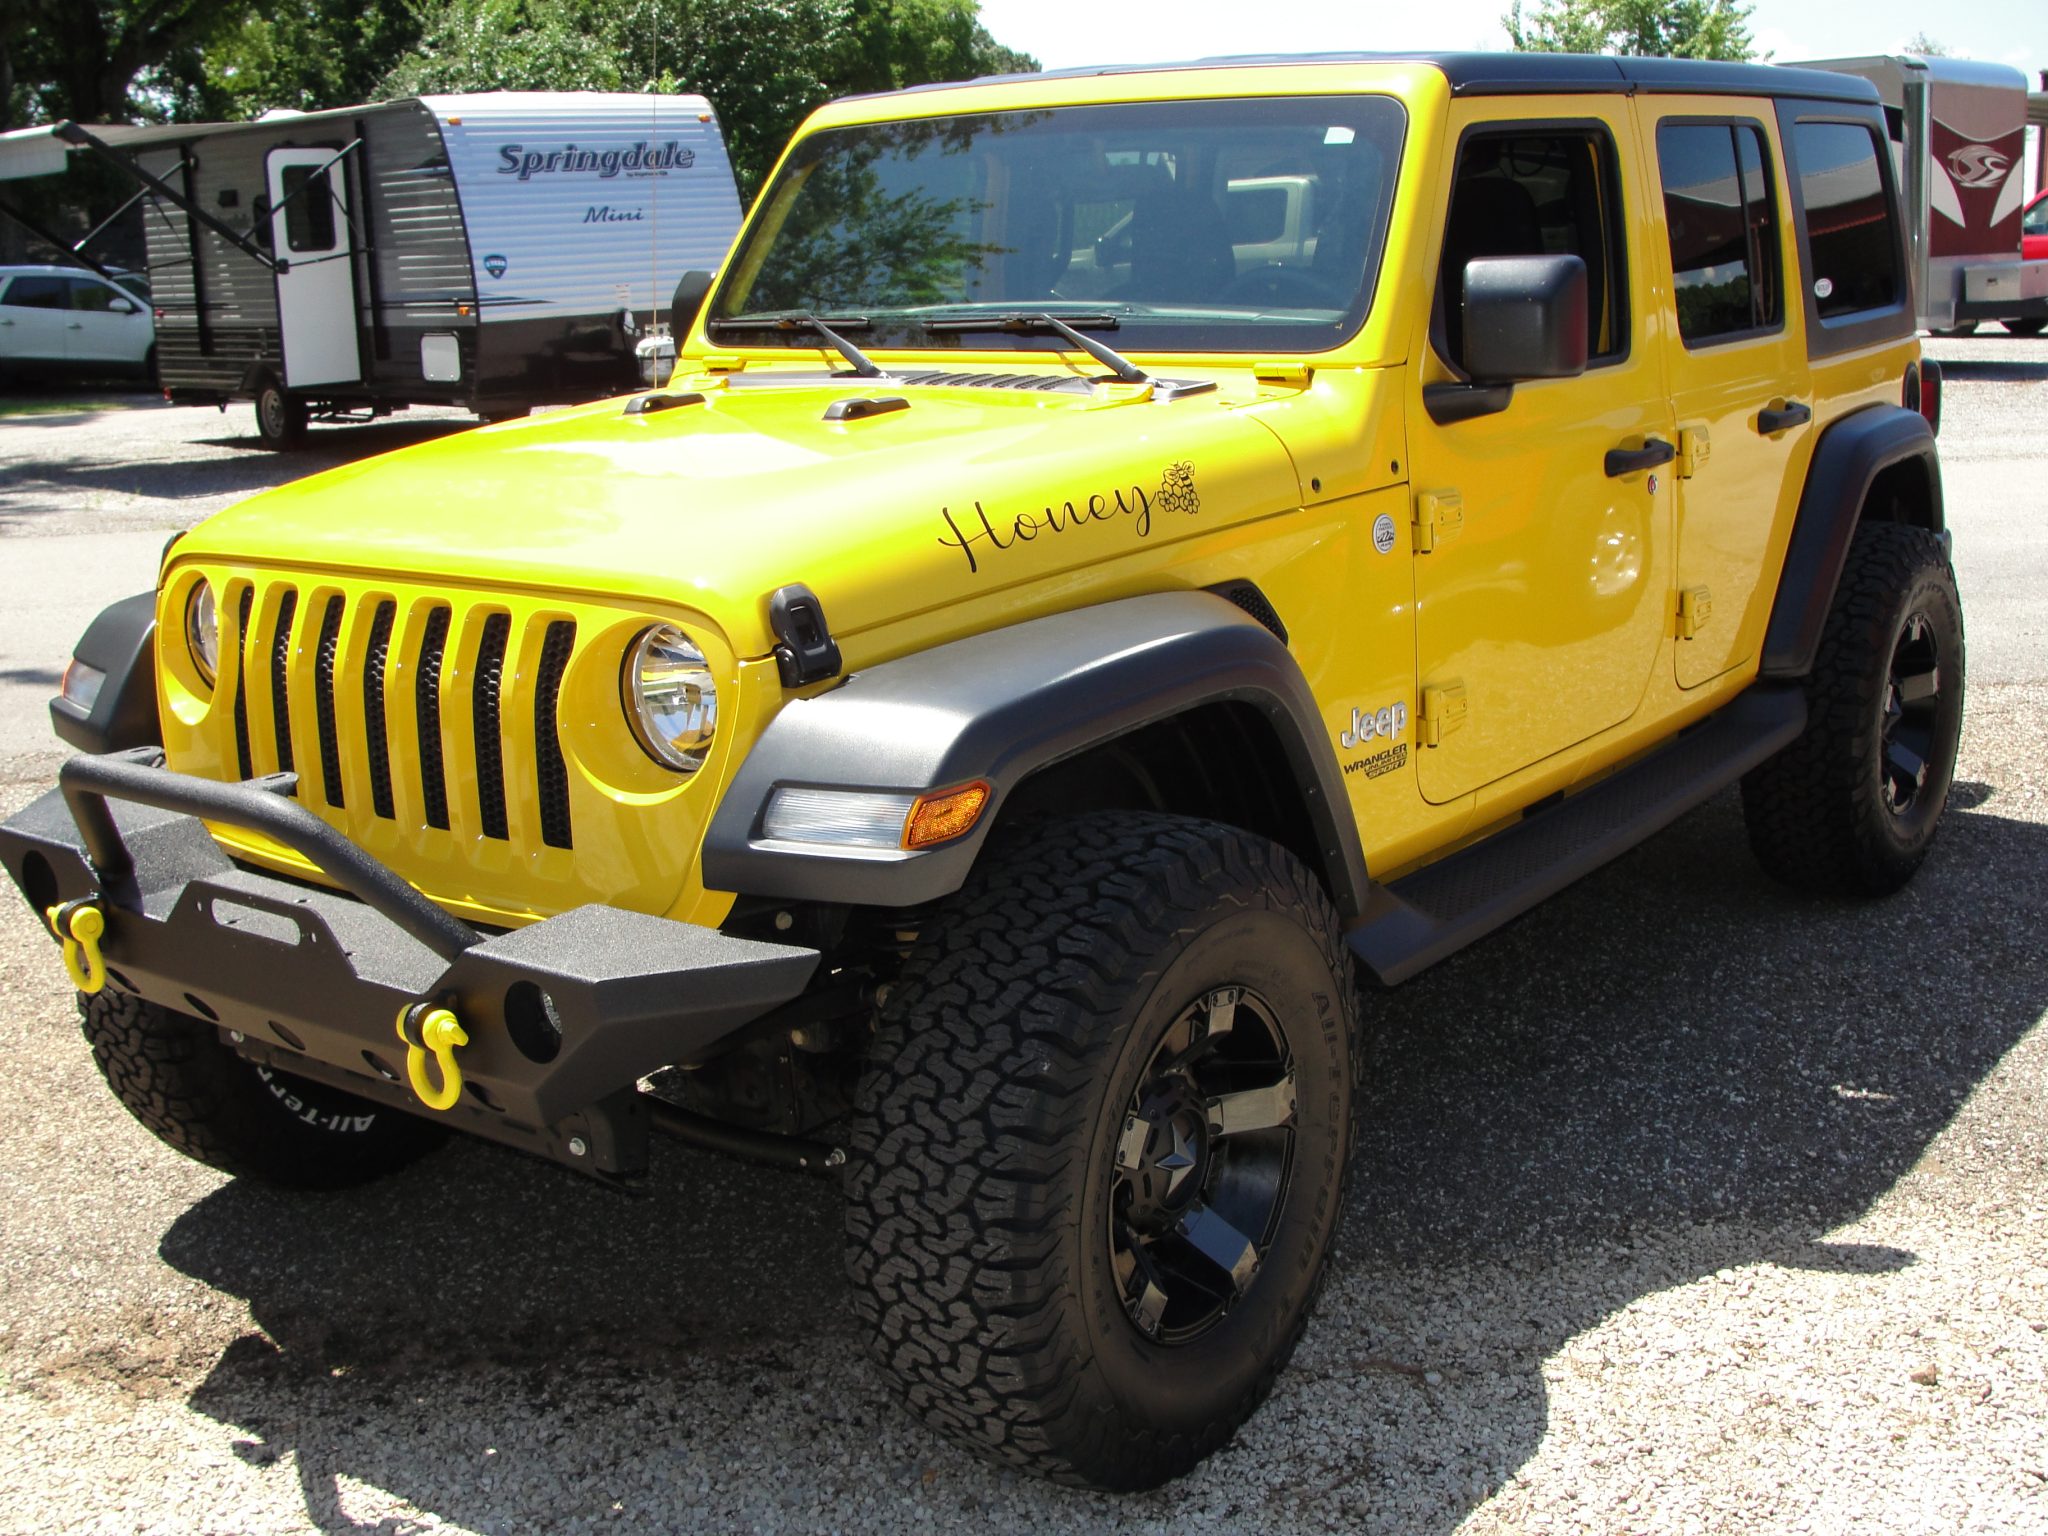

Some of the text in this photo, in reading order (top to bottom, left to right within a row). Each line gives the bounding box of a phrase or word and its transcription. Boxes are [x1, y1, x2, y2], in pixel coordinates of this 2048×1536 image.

[497, 141, 695, 180] Springdale
[583, 206, 644, 223] Mini
[938, 486, 1157, 573] Honey
[1341, 701, 1407, 749] Jeep
[1343, 743, 1406, 774] WRANGLER
[1364, 752, 1407, 773] UNLIMITED
[1368, 759, 1406, 778] SPORT
[257, 1067, 376, 1132] All-Terr
